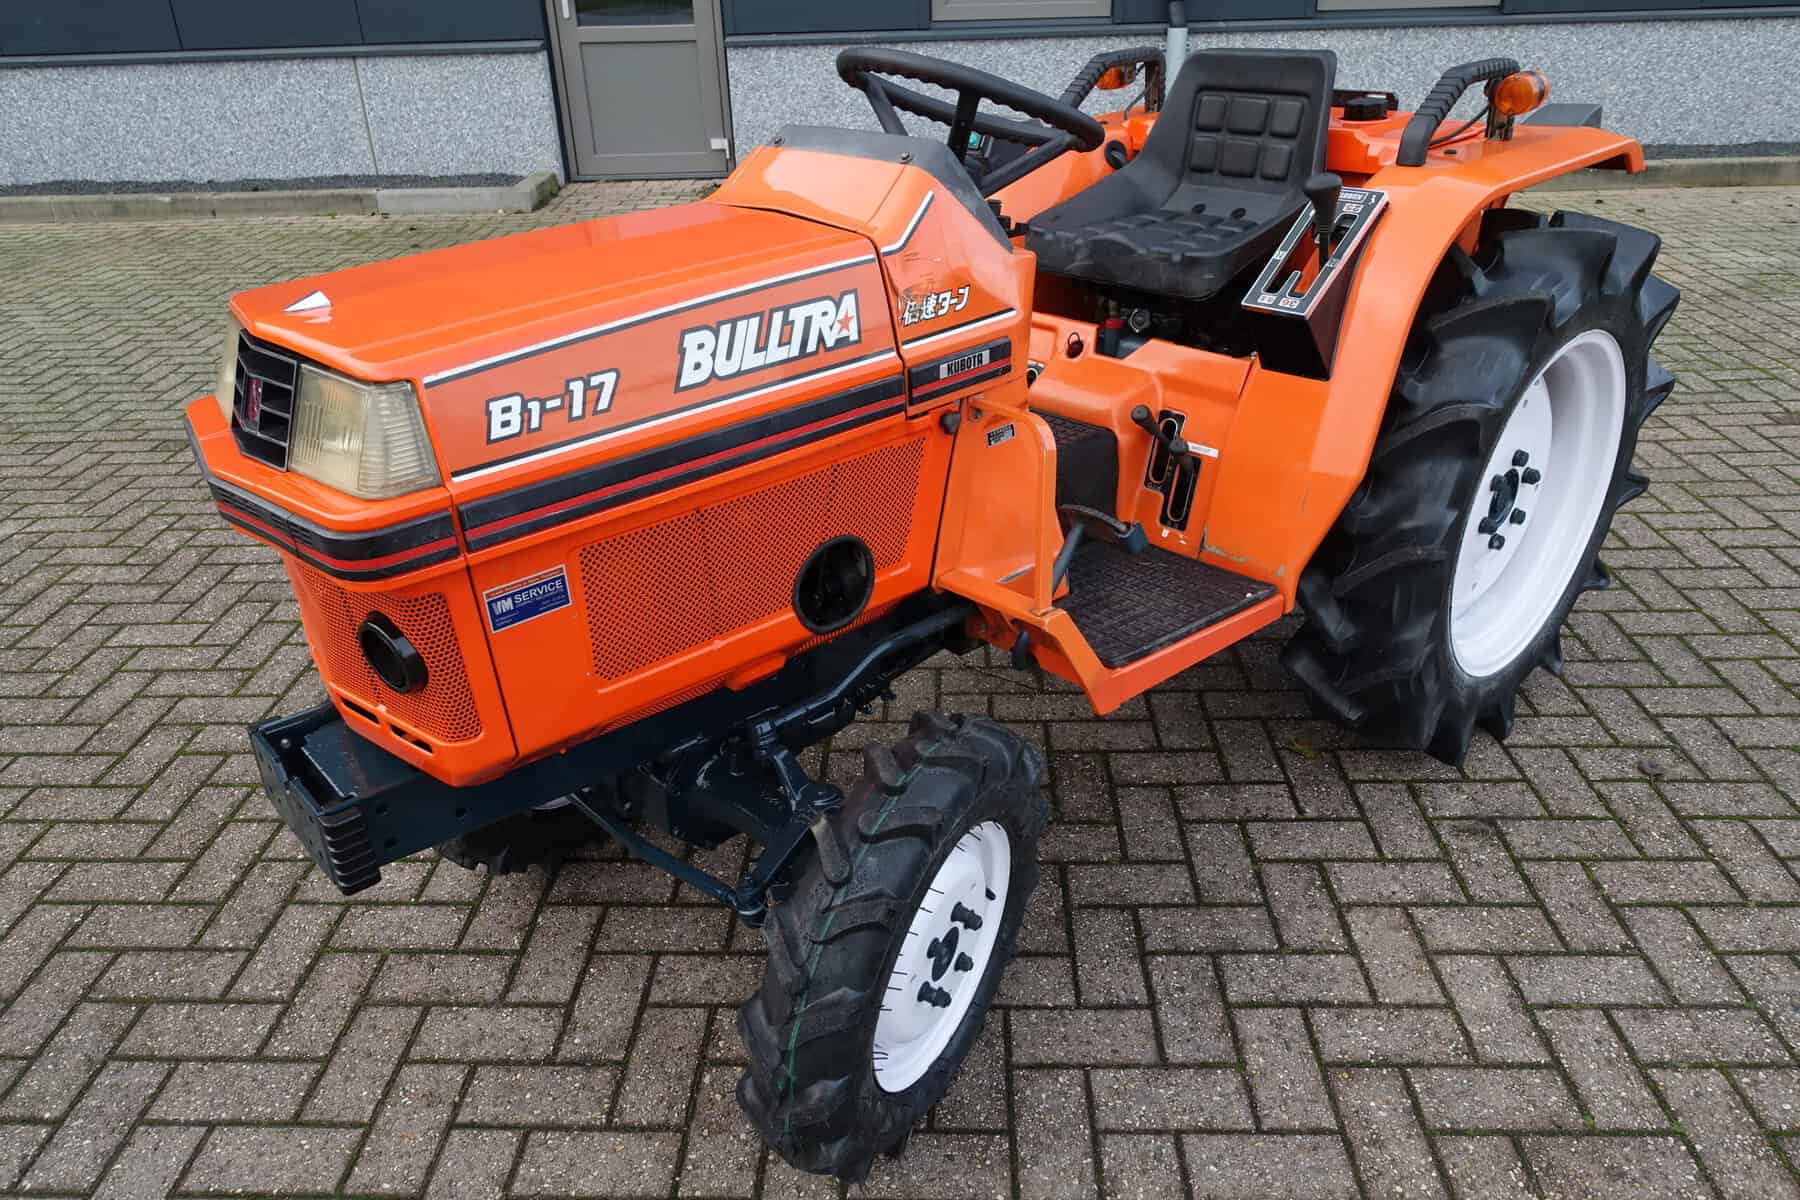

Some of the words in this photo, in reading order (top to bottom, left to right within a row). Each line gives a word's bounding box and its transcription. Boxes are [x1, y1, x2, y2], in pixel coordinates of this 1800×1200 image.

[676, 289, 860, 391] BULLTRA
[946, 353, 984, 377] KUBOTA
[487, 369, 619, 443] B1-17
[513, 579, 563, 604] SERVICE
